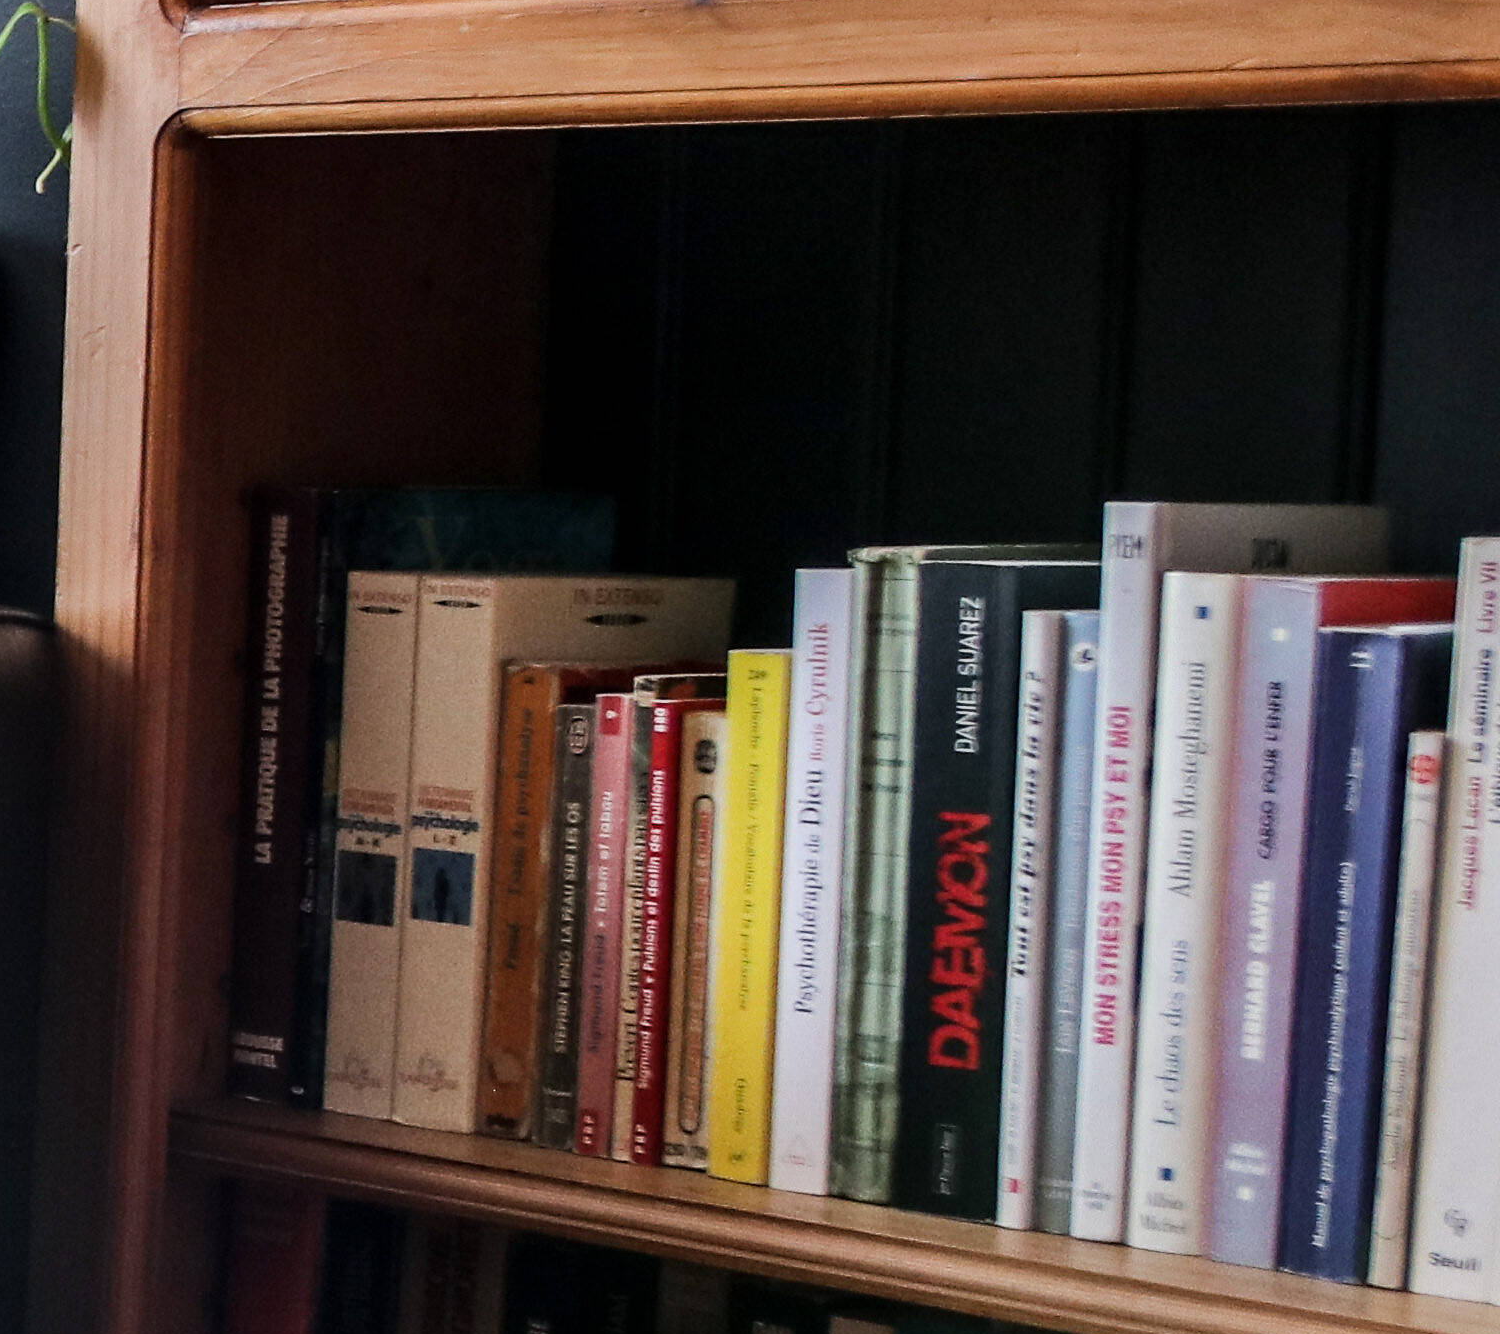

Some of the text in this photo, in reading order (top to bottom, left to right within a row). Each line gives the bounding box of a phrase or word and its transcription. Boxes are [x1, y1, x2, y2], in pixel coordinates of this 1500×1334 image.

[1475, 590, 1495, 634] Livre
[1478, 560, 1497, 585] VII
[254, 514, 289, 865] LA PRATIQUE DE LA PHOTOGRAPHIE
[954, 597, 984, 755] DANIEL SUAREZ
[1023, 693, 1042, 727] vie
[1468, 648, 1494, 737] séminaire
[1018, 770, 1038, 831] dans
[1021, 738, 1039, 760] la
[1170, 661, 1208, 899] Ahlam Mosteghanemi
[1256, 681, 1284, 860] CARGO POUR L'ENFER
[1462, 777, 1484, 831] Lacan
[1466, 742, 1486, 765] Le
[794, 623, 830, 1015] Psychothérapie de Dieu Boris Cyrulnik
[1015, 836, 1034, 879] psy
[1093, 708, 1130, 1047] MON STRESS MON PSY ET MOI
[1458, 836, 1481, 912] Jacques
[553, 802, 580, 1055] STEPHEN KING LA PEAU SUR LES OS
[589, 792, 614, 1054] Sigmund Freud Totem et tabou
[637, 770, 664, 1091] Sigmund Freud Pulsions et destin des pulsions
[928, 812, 991, 1070] DAEMON
[1010, 928, 1029, 979] Tout
[1013, 886, 1031, 919] est
[1241, 881, 1274, 1060] BERNARD CLAVEL
[1155, 939, 1188, 1126] Le chaos des sens
[1311, 863, 1355, 1247] Manuel de psychopathologie psychanalytique (enfant et adulte)
[1428, 1251, 1476, 1270] Seuil
